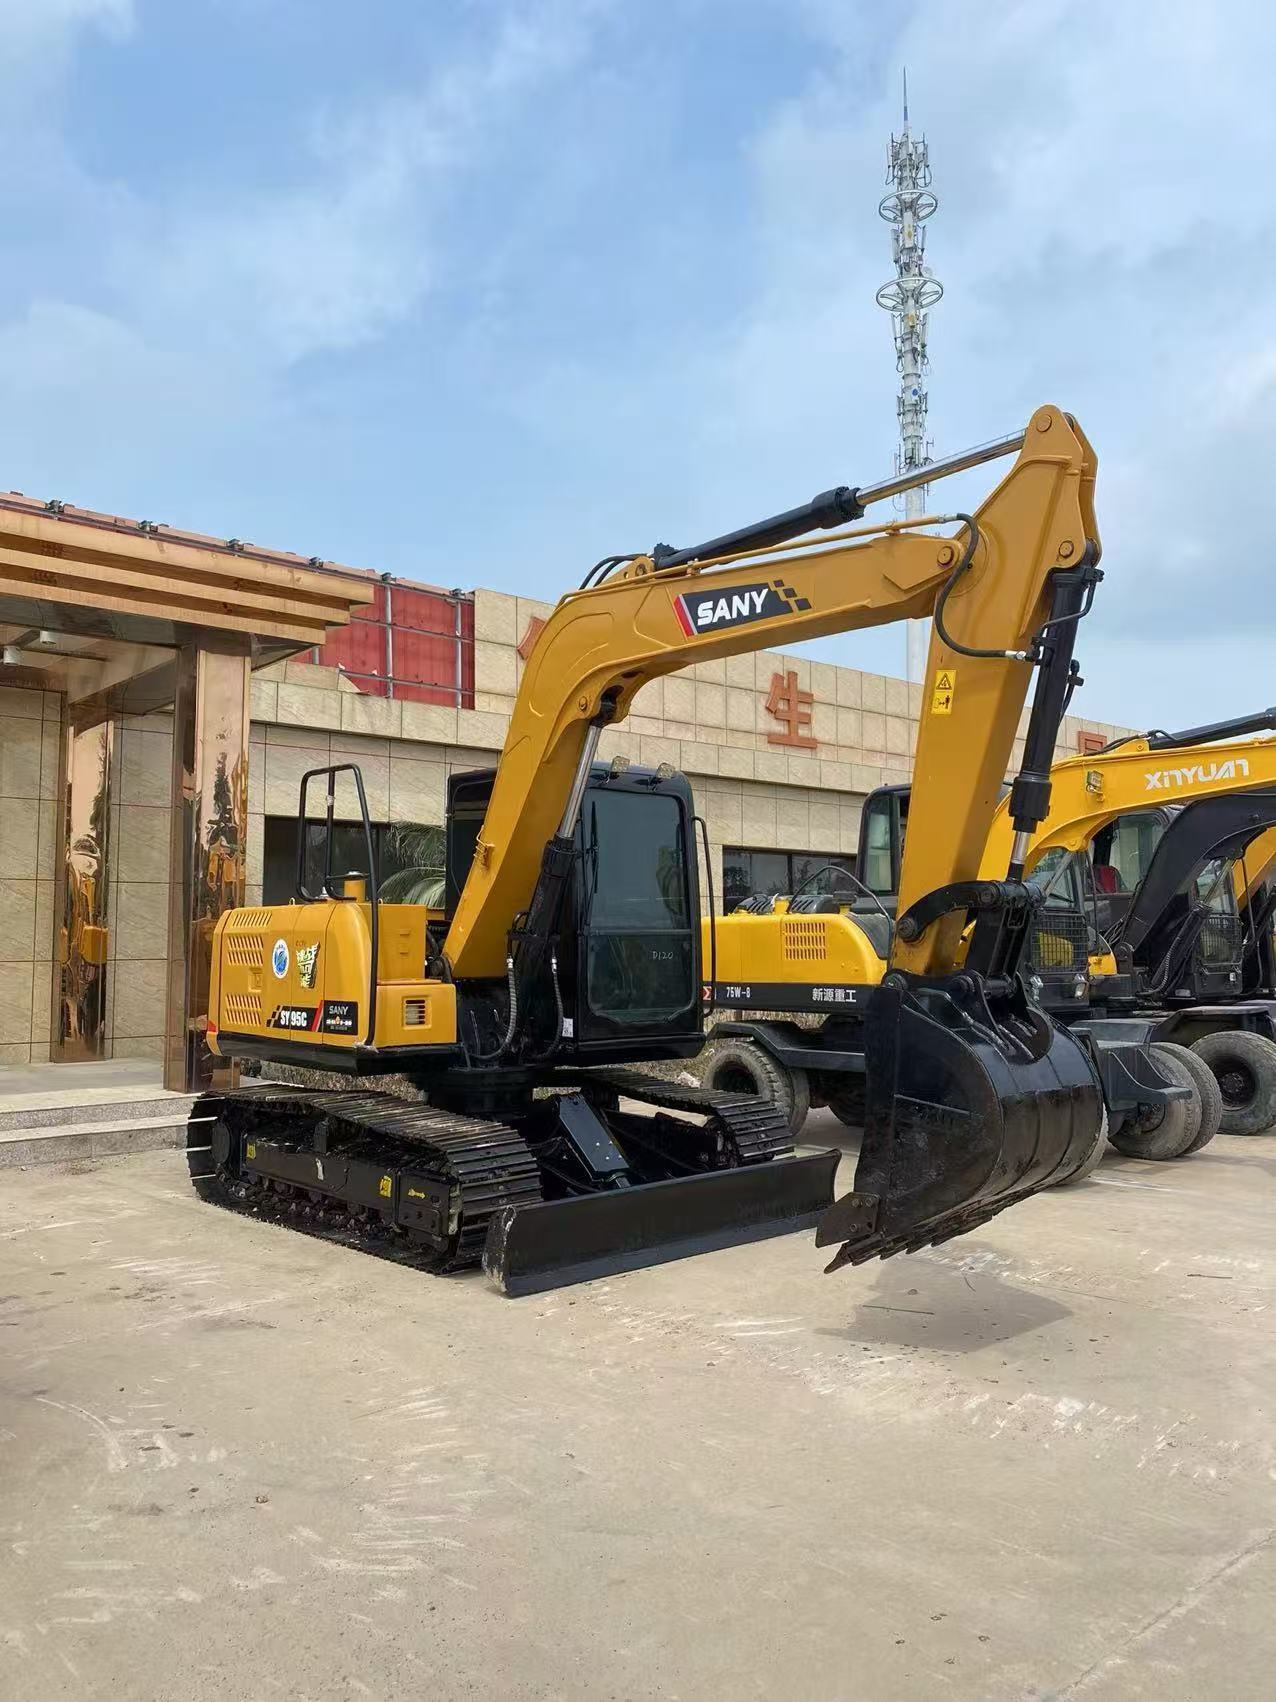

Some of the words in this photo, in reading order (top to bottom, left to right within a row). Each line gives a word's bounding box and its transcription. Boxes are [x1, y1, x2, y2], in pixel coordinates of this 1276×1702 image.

[697, 588, 769, 627] SANY
[812, 987, 857, 1002] 新源重工
[328, 1005, 349, 1016] SANY
